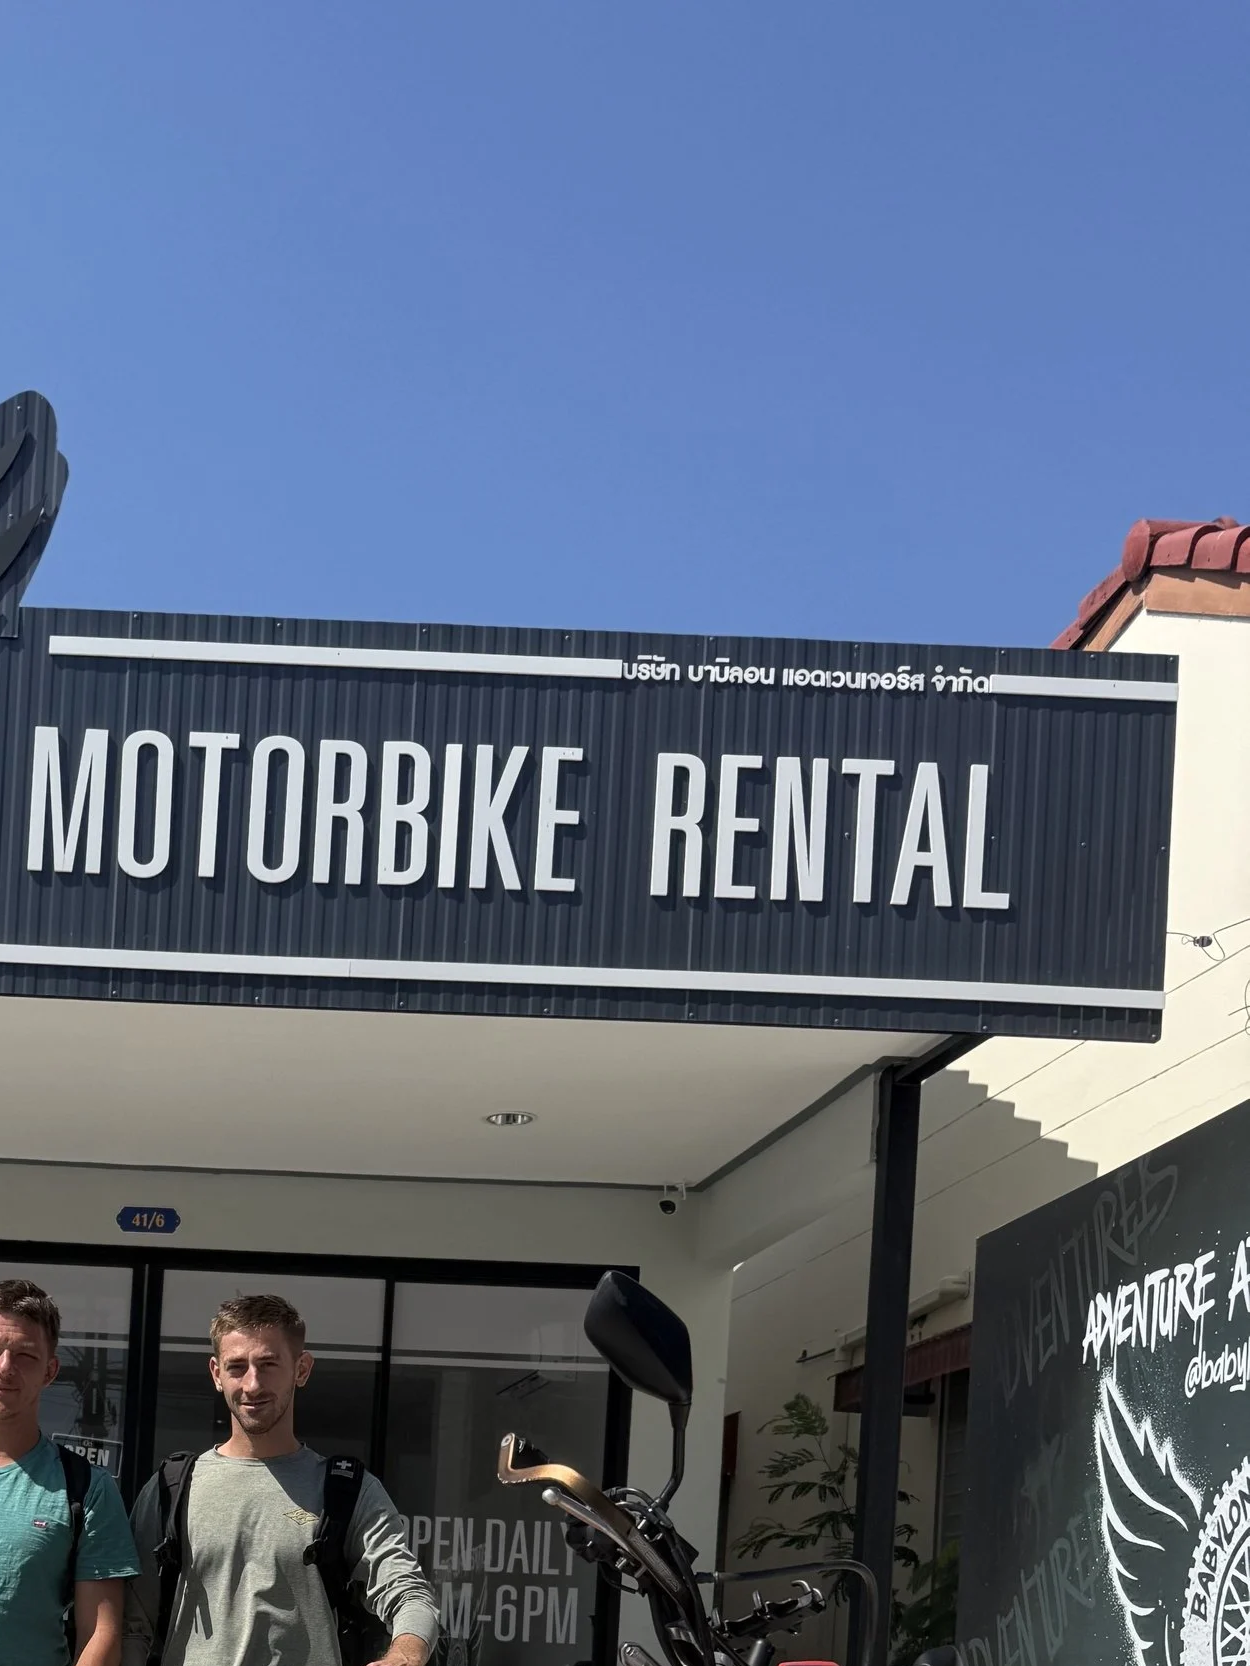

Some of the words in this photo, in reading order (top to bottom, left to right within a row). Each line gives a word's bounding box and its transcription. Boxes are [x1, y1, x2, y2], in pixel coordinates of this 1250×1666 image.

[622, 654, 681, 682] บริษัท
[931, 664, 991, 695] จำกัด
[26, 725, 584, 893] MOTORBIKE
[649, 752, 1010, 910] RENTAL
[131, 1211, 165, 1230] 41/6
[1082, 1250, 1216, 1372] ADVENTURE
[1228, 1238, 1250, 1322] A
[483, 1518, 576, 1577] DAILY
